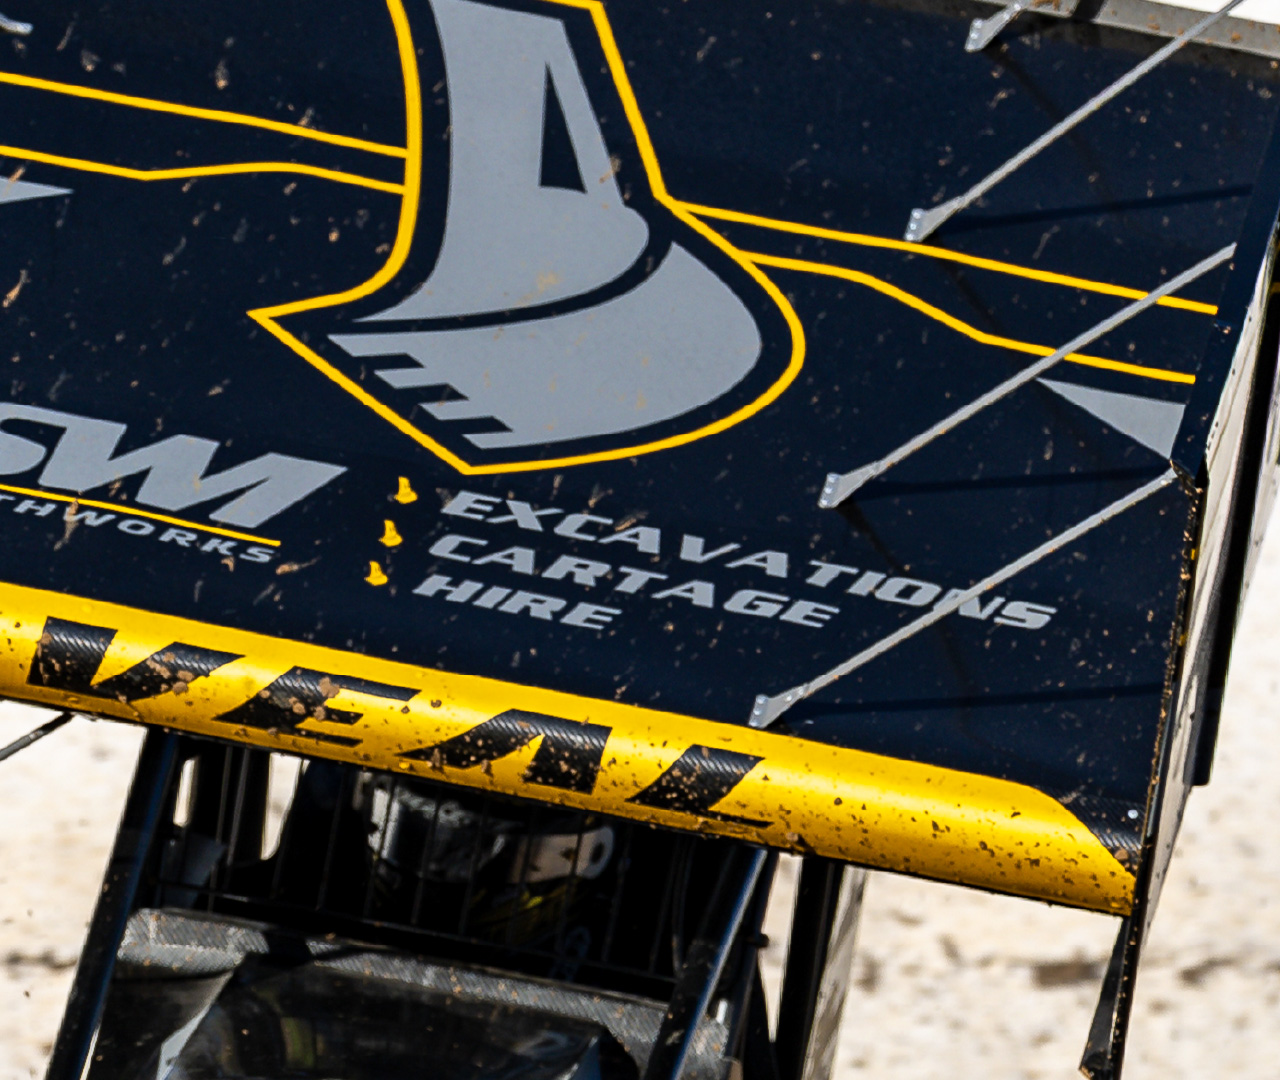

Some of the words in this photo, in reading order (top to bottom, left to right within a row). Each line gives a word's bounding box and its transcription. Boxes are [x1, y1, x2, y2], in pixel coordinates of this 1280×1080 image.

[412, 574, 621, 630] HIRE
[428, 533, 840, 628] CARTAGE
[440, 490, 1057, 630] EXCAVATIONS
[29, 616, 776, 829] VEAL
